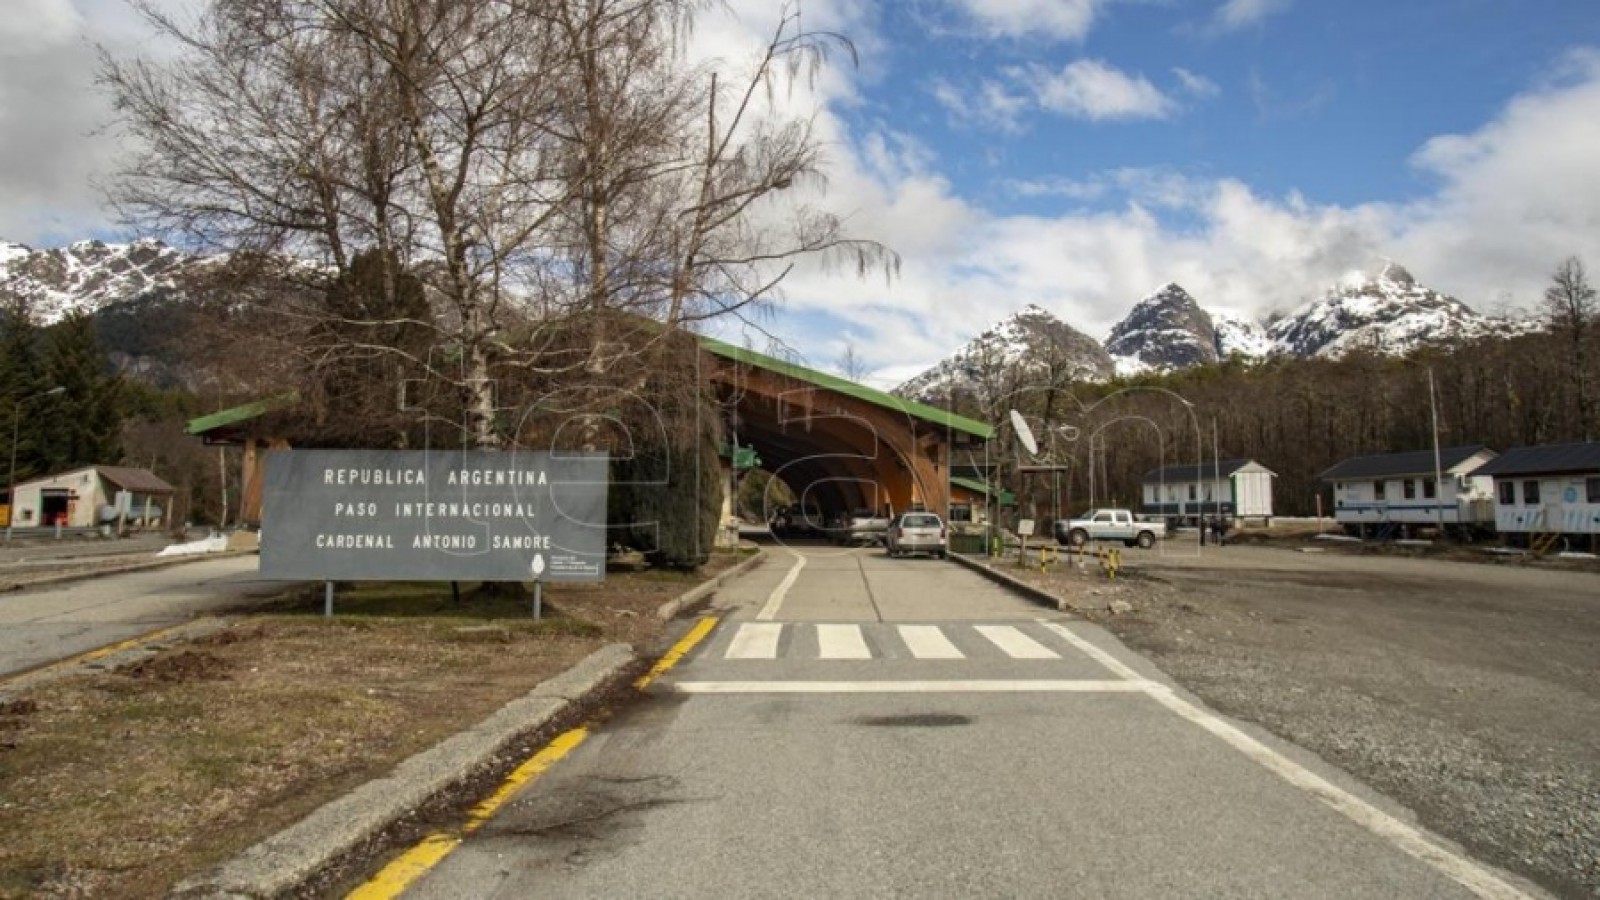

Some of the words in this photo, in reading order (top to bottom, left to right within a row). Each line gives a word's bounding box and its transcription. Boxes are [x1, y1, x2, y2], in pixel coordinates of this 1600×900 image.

[324, 469, 425, 485] REPUBLICA
[448, 470, 547, 485] ARGENTINA
[335, 502, 377, 517] PASO
[395, 502, 535, 517] INTERNACIONAL
[316, 534, 394, 549] CARDENAL
[412, 534, 476, 549] ANTONIO
[492, 534, 551, 549] SAMORE
